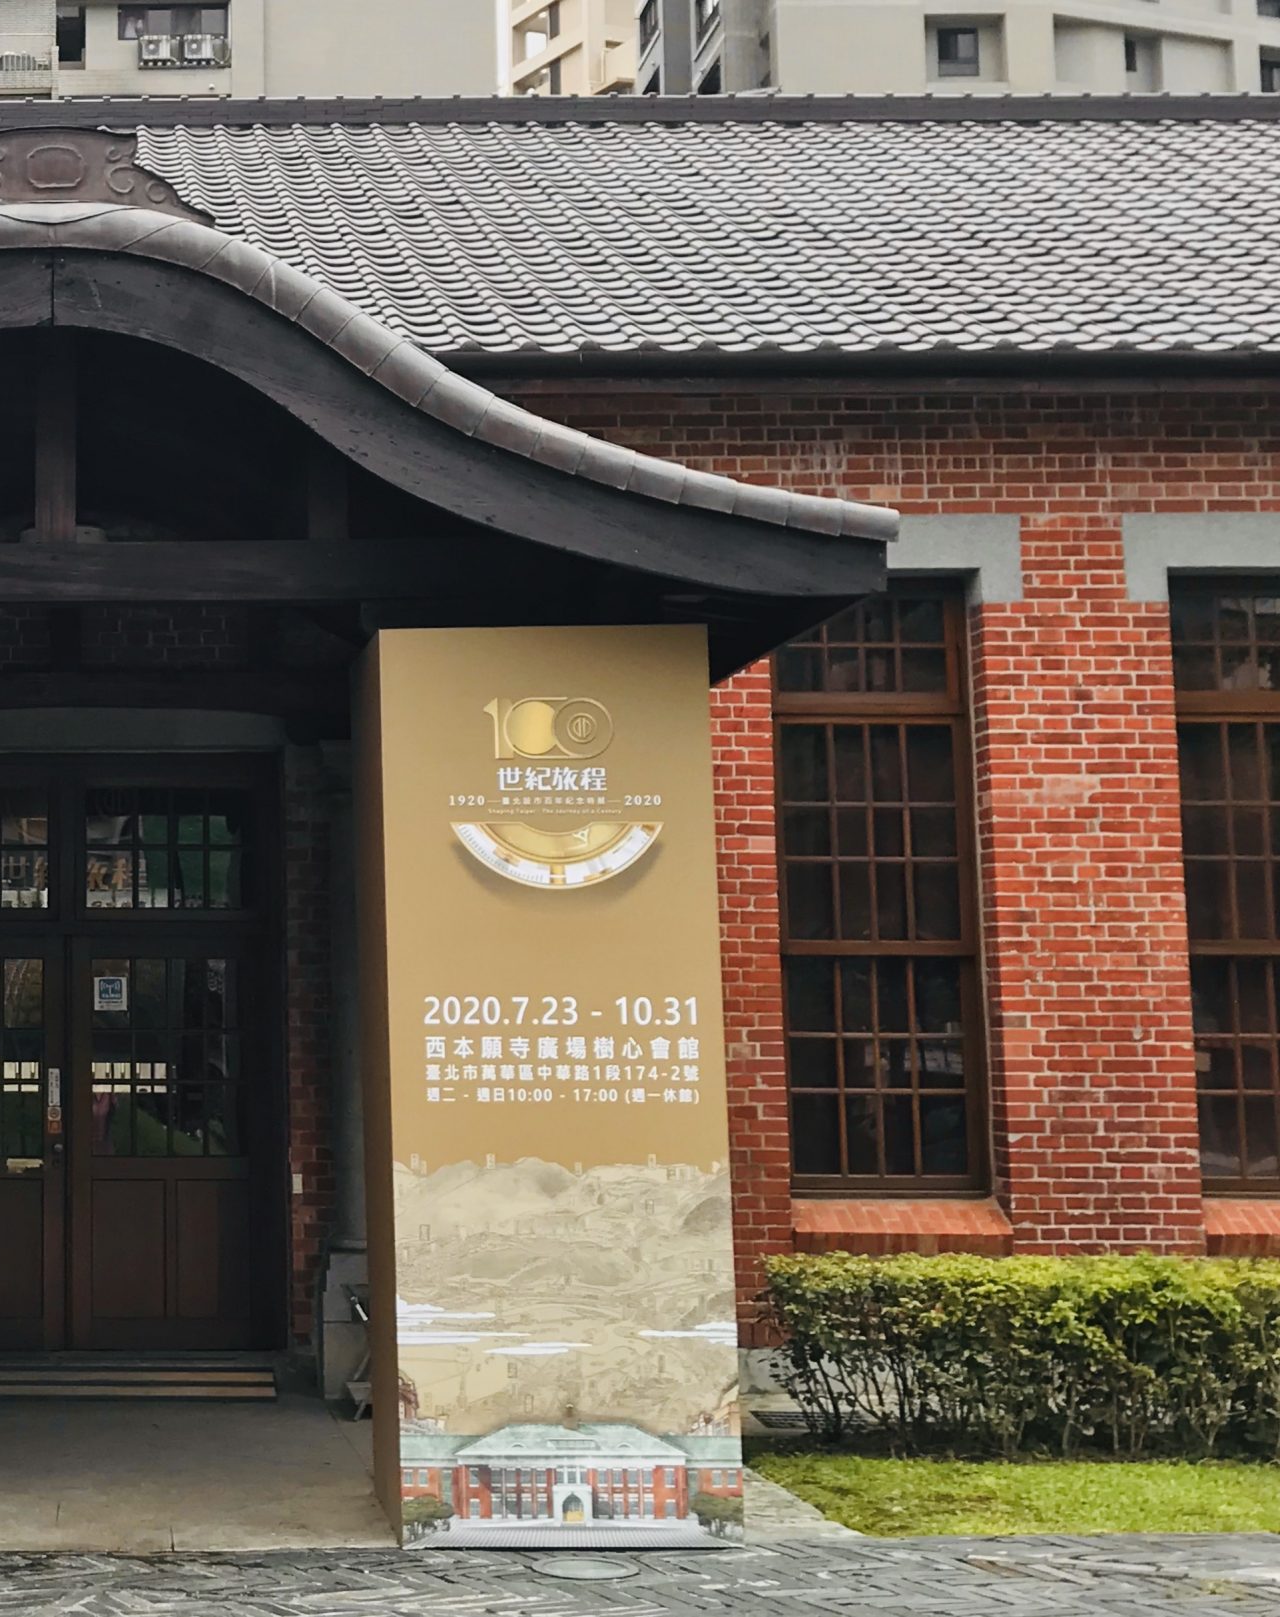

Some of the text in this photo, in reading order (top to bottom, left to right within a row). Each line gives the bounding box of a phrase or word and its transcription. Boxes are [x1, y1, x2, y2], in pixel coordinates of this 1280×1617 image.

[496, 766, 608, 791] 世紀旅程
[449, 795, 486, 806] 1920
[624, 795, 662, 806] 2020
[423, 996, 579, 1026] 2020.7.23
[615, 996, 698, 1026] 10.31
[424, 1035, 700, 1060] 西本願寺廣場樹心會館
[425, 1063, 700, 1082] 臺北市萬華區中華路1段174-2號
[573, 1088, 618, 1102] 17:00
